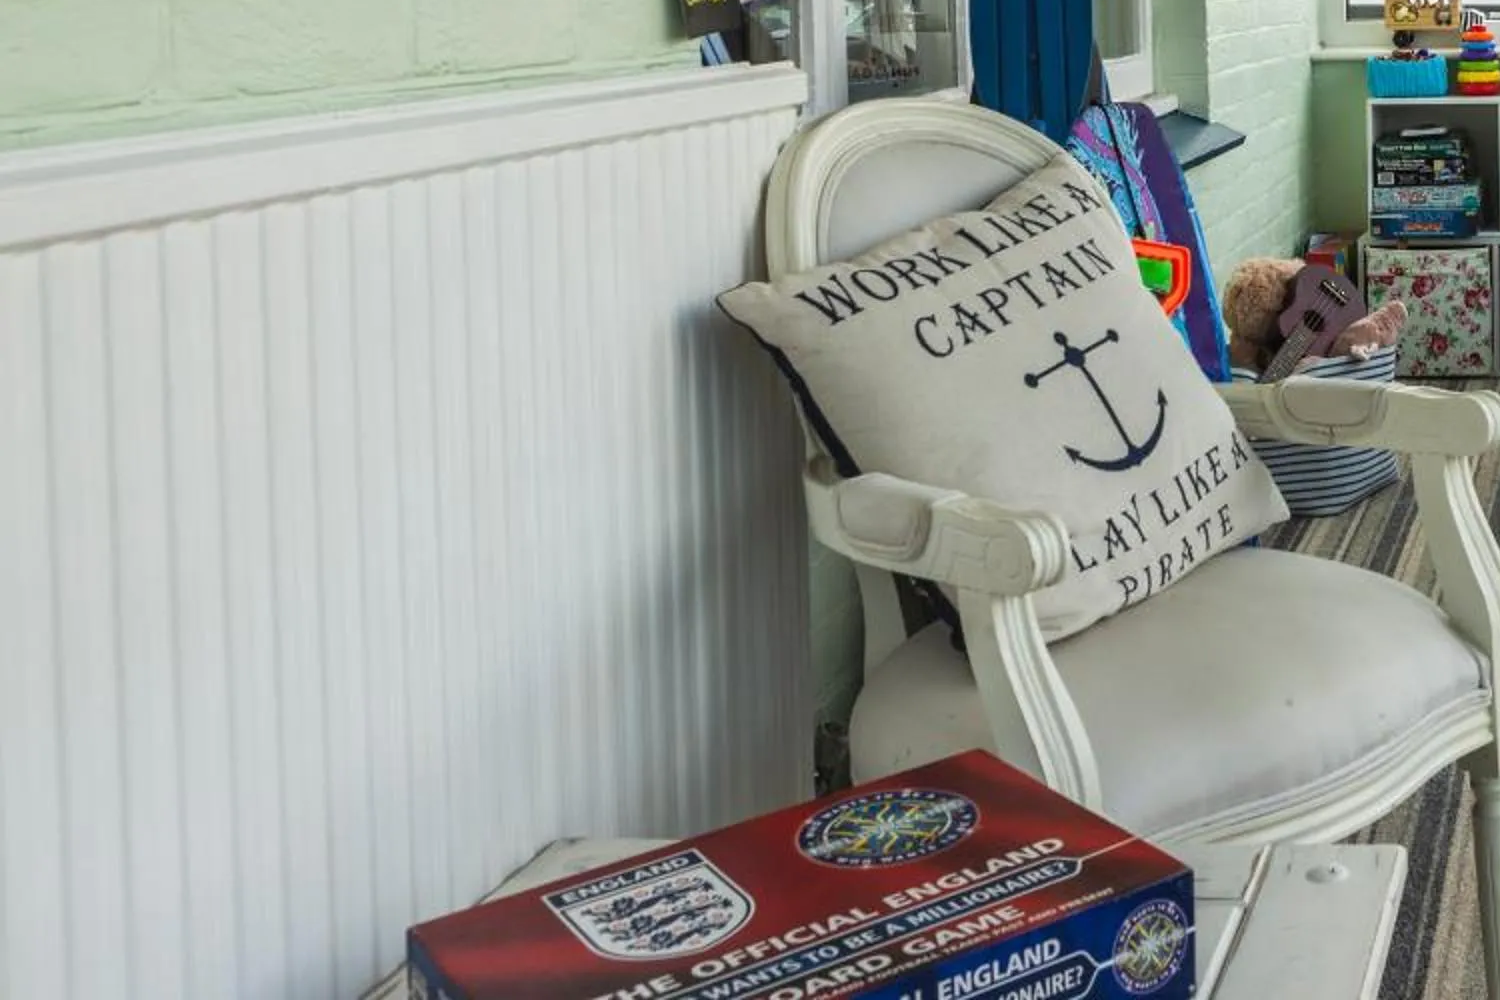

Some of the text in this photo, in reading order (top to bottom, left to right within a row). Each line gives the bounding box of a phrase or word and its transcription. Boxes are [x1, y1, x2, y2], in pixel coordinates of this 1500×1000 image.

[793, 182, 1103, 326] WORK LIKE A
[914, 238, 1117, 358] CAPTAIN
[1070, 431, 1249, 573] LAY LIKE A
[1116, 503, 1234, 606] PIRATE
[561, 856, 691, 904] ENGLAND
[691, 907, 880, 978] OFFICIAL
[882, 837, 1065, 909] ENGLAND
[701, 959, 802, 999] WANTS
[801, 945, 839, 963] TO
[842, 929, 885, 949] BE
[885, 923, 906, 936] A
[905, 861, 1070, 927] MILLIONAIRE?
[763, 954, 893, 1000] OARD
[902, 905, 1026, 955] GAME
[937, 937, 1062, 1000] ENGLAND
